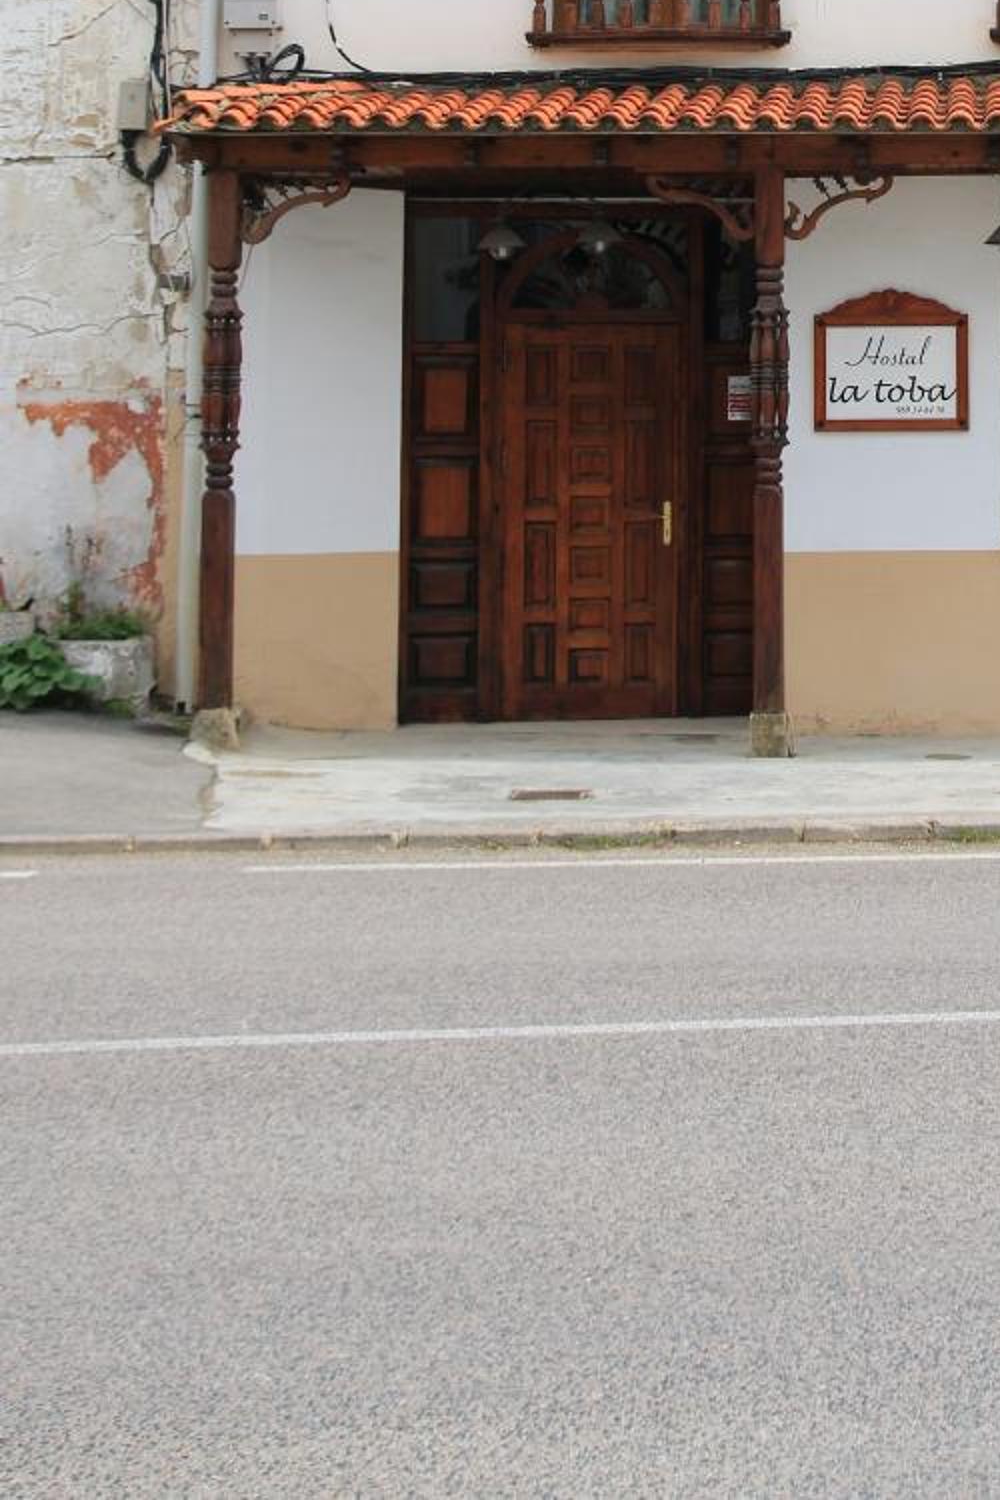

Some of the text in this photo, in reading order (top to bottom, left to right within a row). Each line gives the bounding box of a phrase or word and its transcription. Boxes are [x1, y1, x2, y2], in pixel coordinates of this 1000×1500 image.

[844, 334, 932, 367] Hostal
[829, 375, 957, 403] la toba
